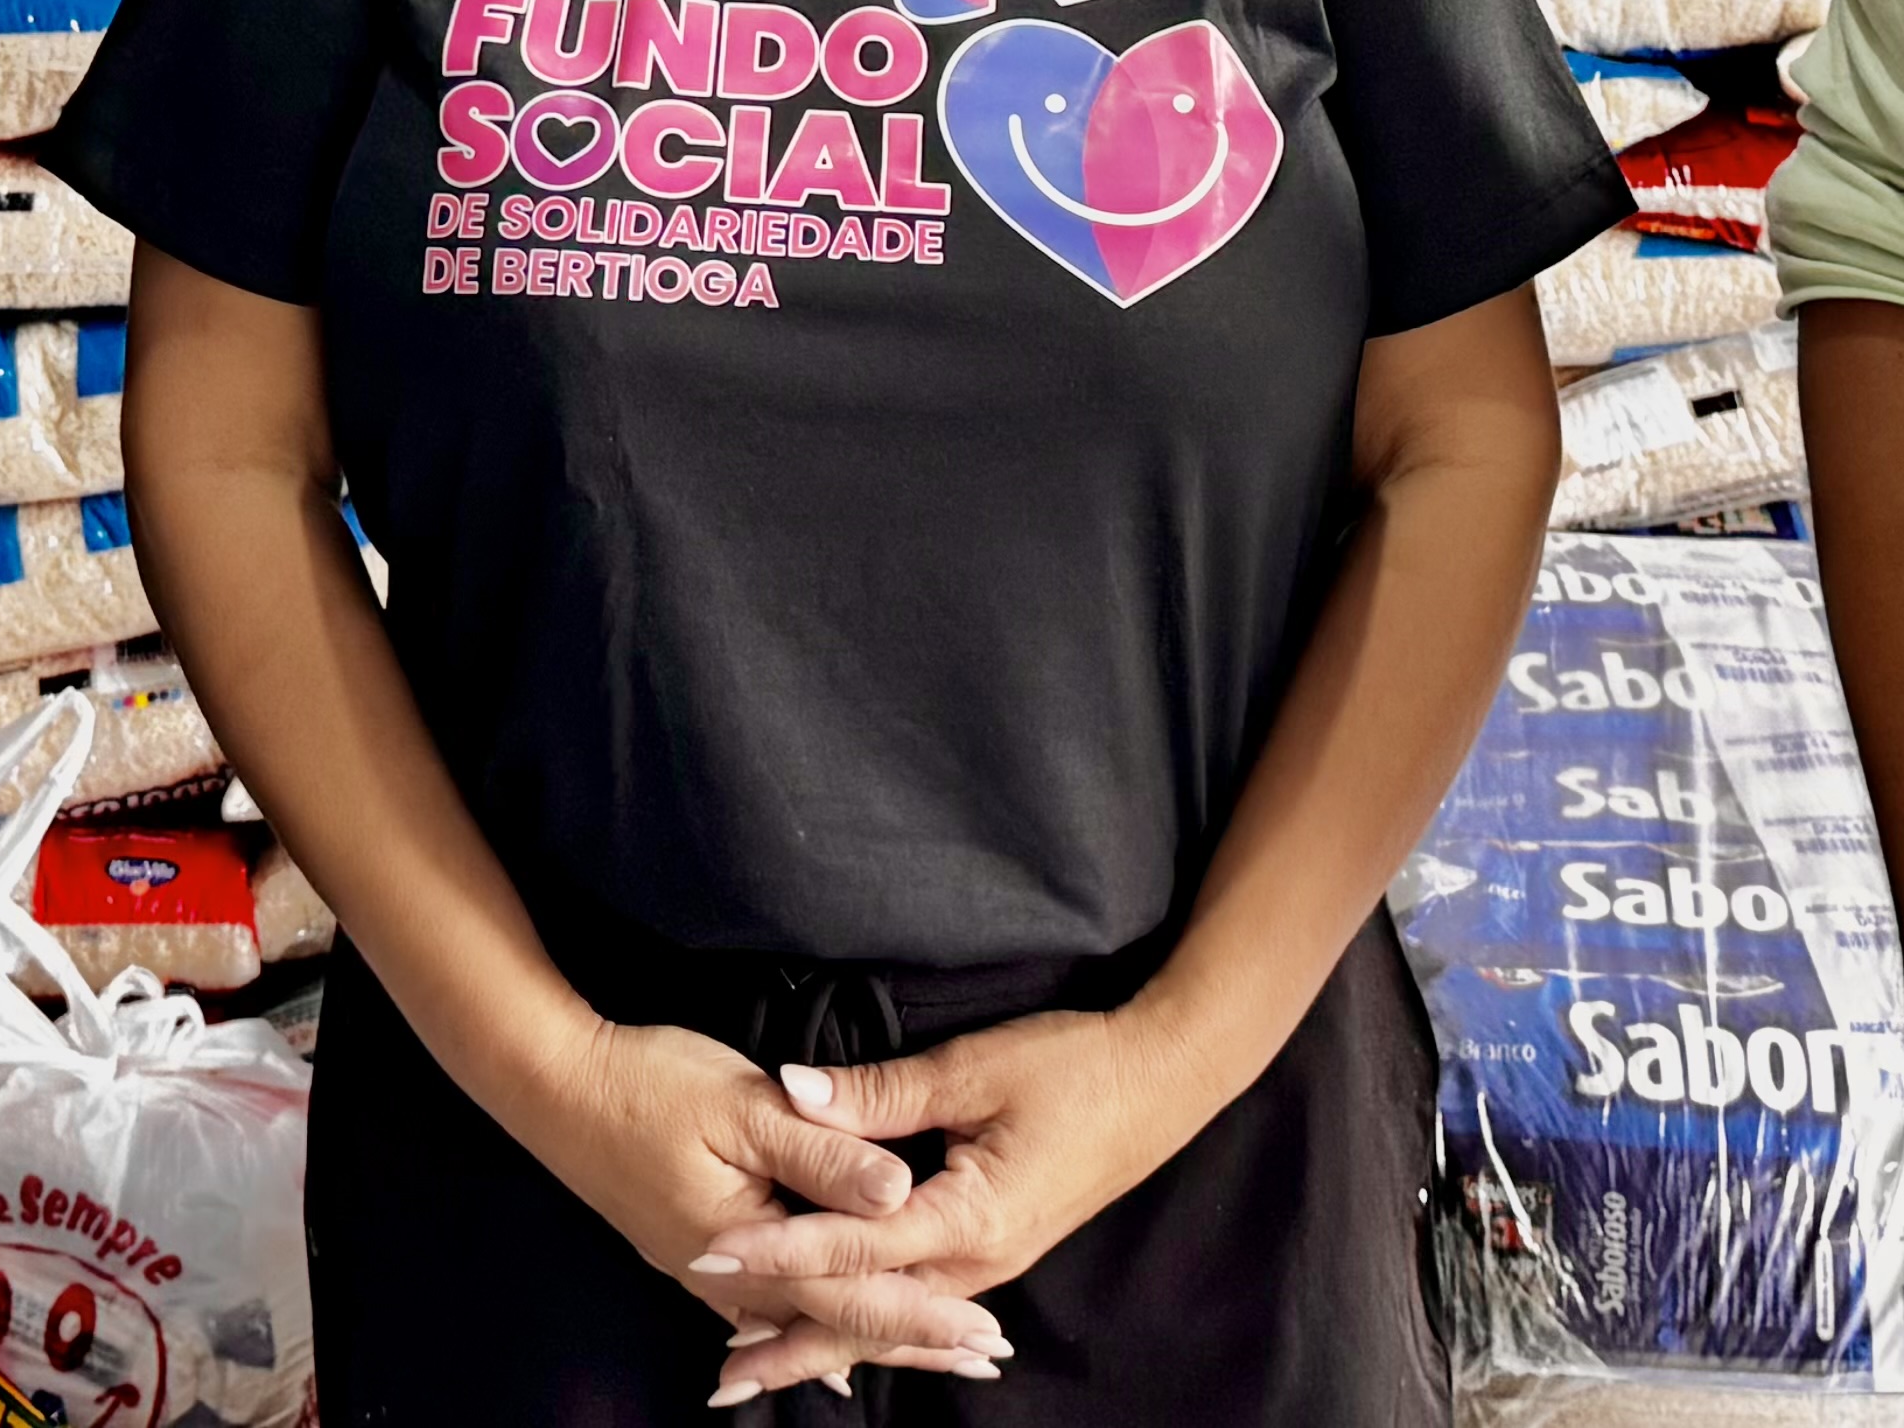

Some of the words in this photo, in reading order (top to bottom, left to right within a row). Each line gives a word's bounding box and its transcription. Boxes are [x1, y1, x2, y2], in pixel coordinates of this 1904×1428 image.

[437, 81, 952, 215] SOCIAL
[422, 245, 479, 295] DE
[492, 247, 780, 310] BERTIOGA
[427, 192, 490, 240] DE
[497, 193, 947, 266] SOLIDARIEDADE
[19, 1172, 183, 1286] Sempre
[1593, 1190, 1628, 1317] Saboroso
